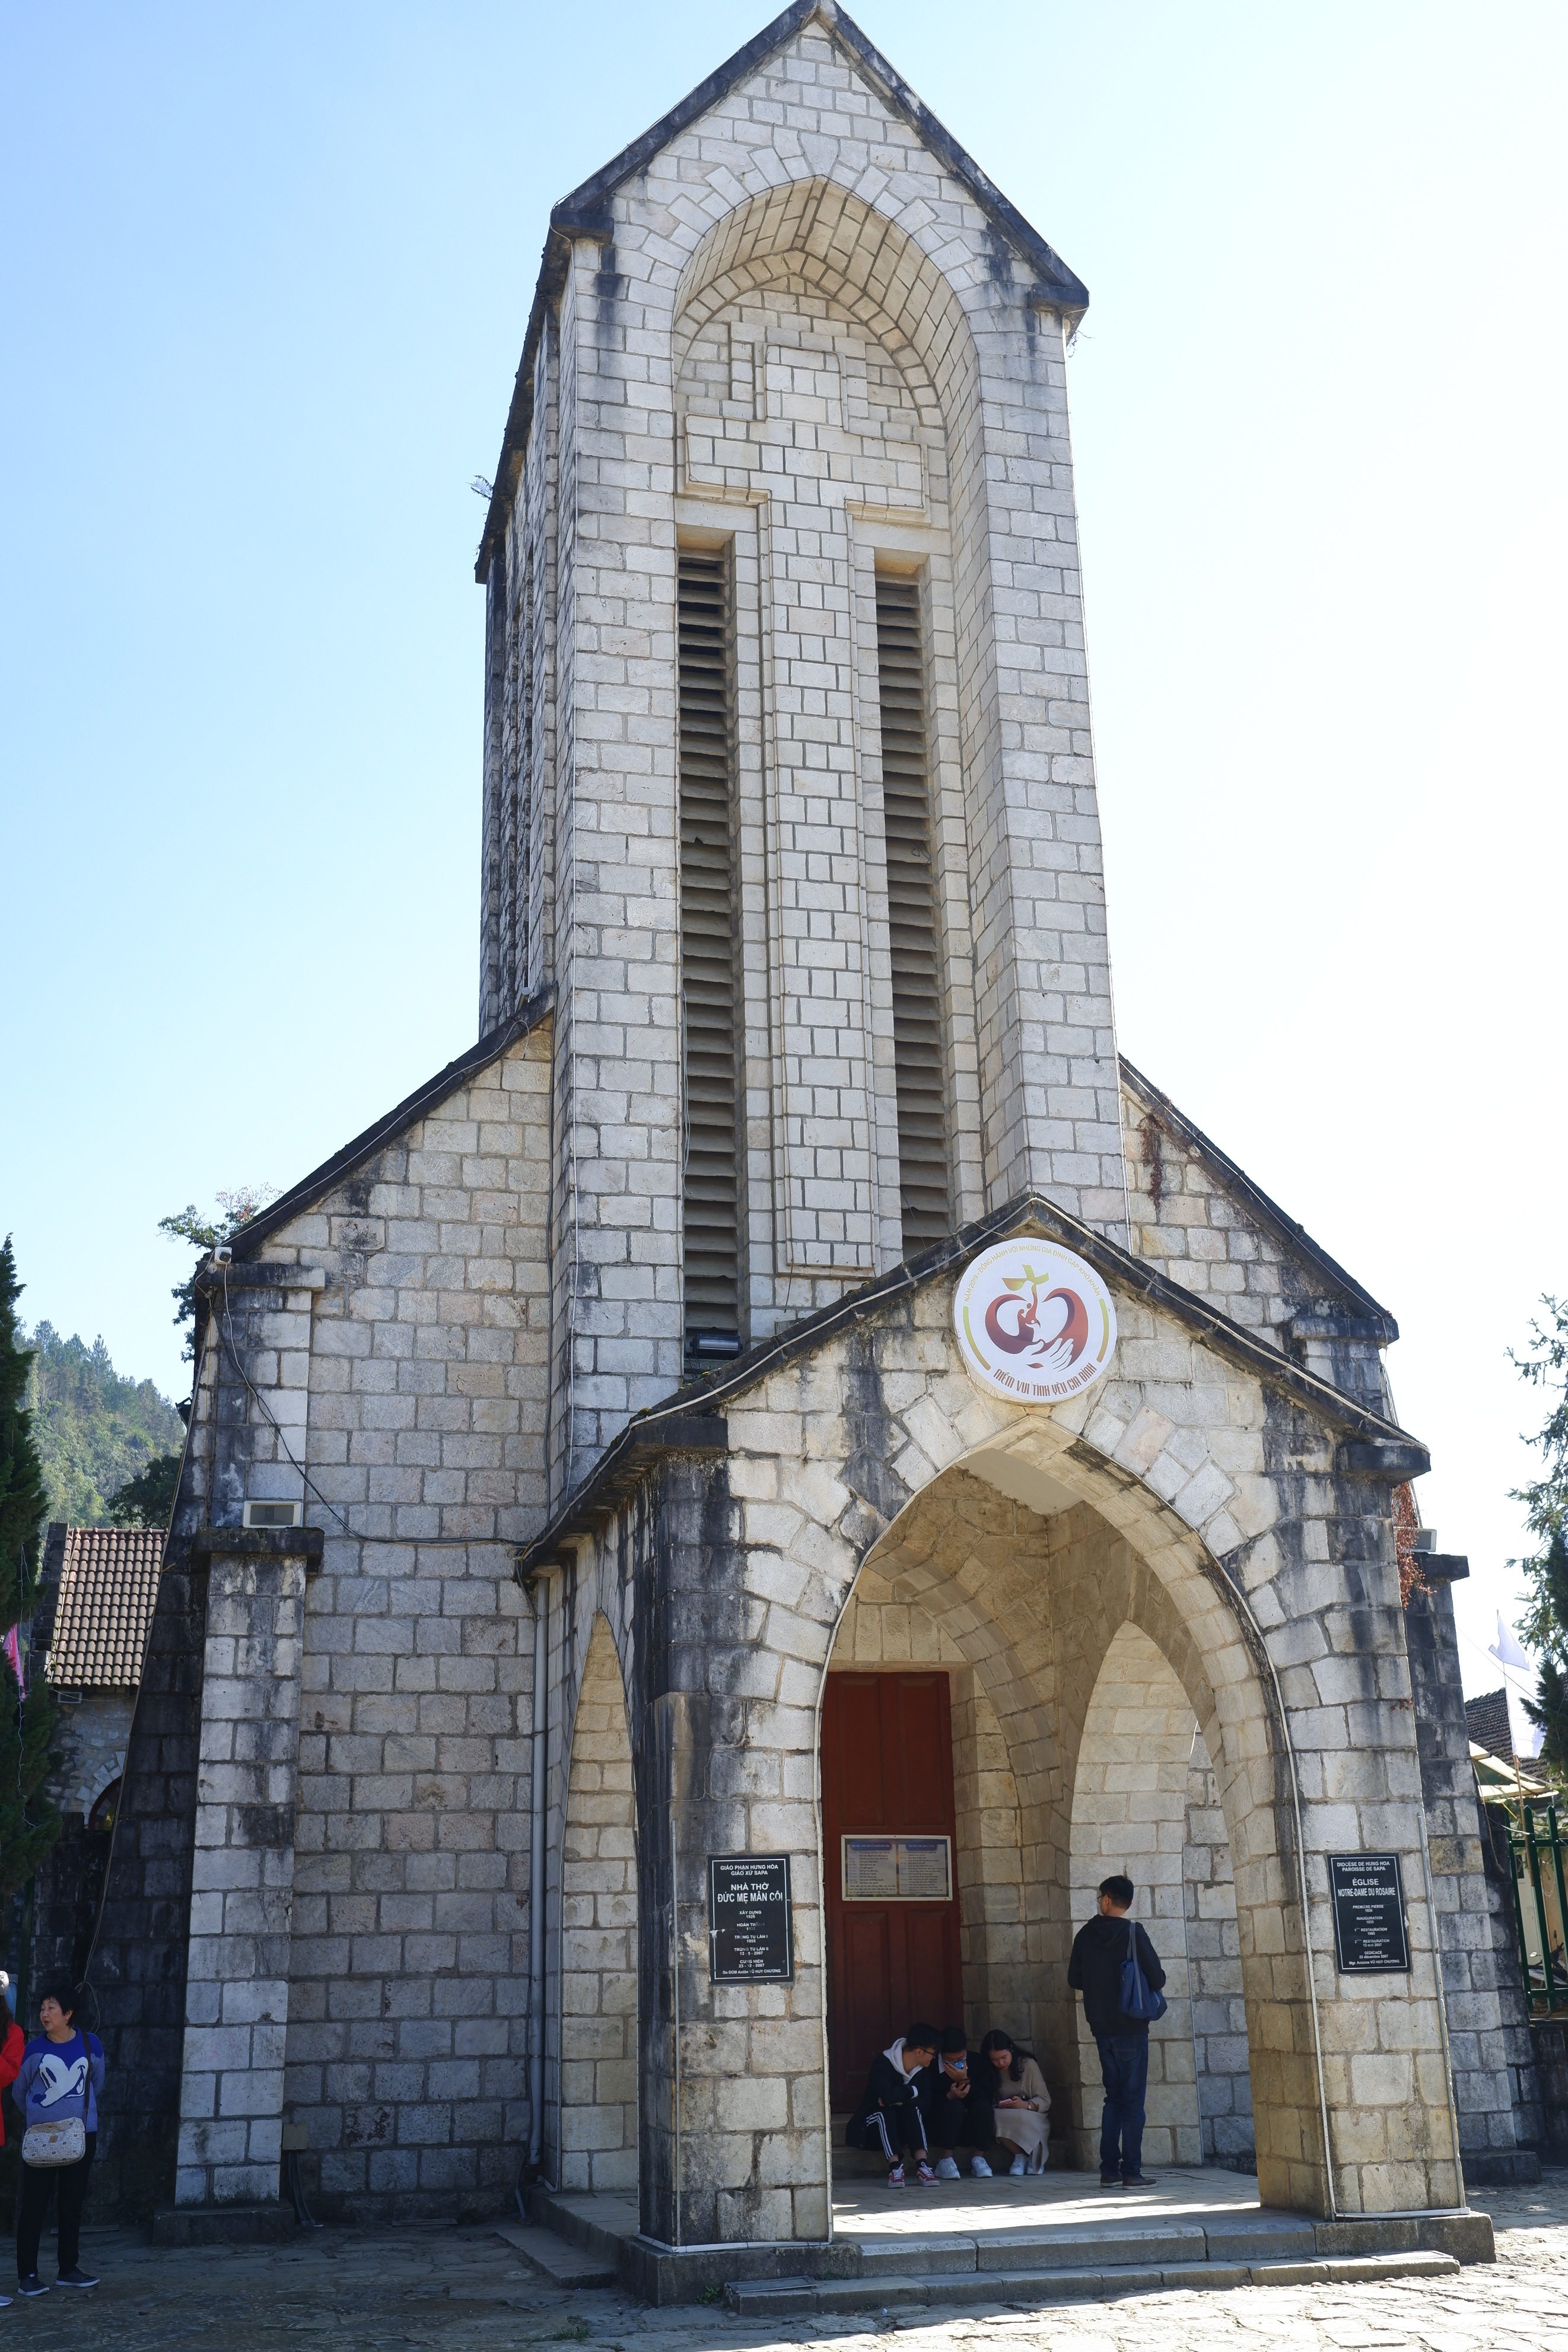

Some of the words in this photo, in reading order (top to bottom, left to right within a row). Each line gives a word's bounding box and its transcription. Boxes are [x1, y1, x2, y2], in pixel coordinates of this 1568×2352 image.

[969, 1274, 979, 1288] 2019
[991, 1250, 1008, 1261] HÀNH
[1008, 1245, 1018, 1254] VỚI
[1042, 1246, 1052, 1254] GIA
[1053, 1250, 1067, 1261] ĐÌNH
[1078, 1267, 1091, 1280] KHÓ
[1016, 1380, 1030, 1394] VUI
[1032, 1384, 1051, 1397] TÌNH
[1051, 1381, 1068, 1396] YÊU
[1067, 1376, 1082, 1391] GIA
[731, 1882, 749, 1890] NHÀ
[750, 1882, 769, 1890] THỜ
[1352, 1877, 1379, 1886] ÉGLISE
[717, 1892, 735, 1902] ĐỨC
[737, 1893, 748, 1904] MẸ
[750, 1890, 767, 1902] MÂN
[1338, 1888, 1367, 1897] NOTRE-DAME
[1375, 1887, 1396, 1896] ROSAIRE
